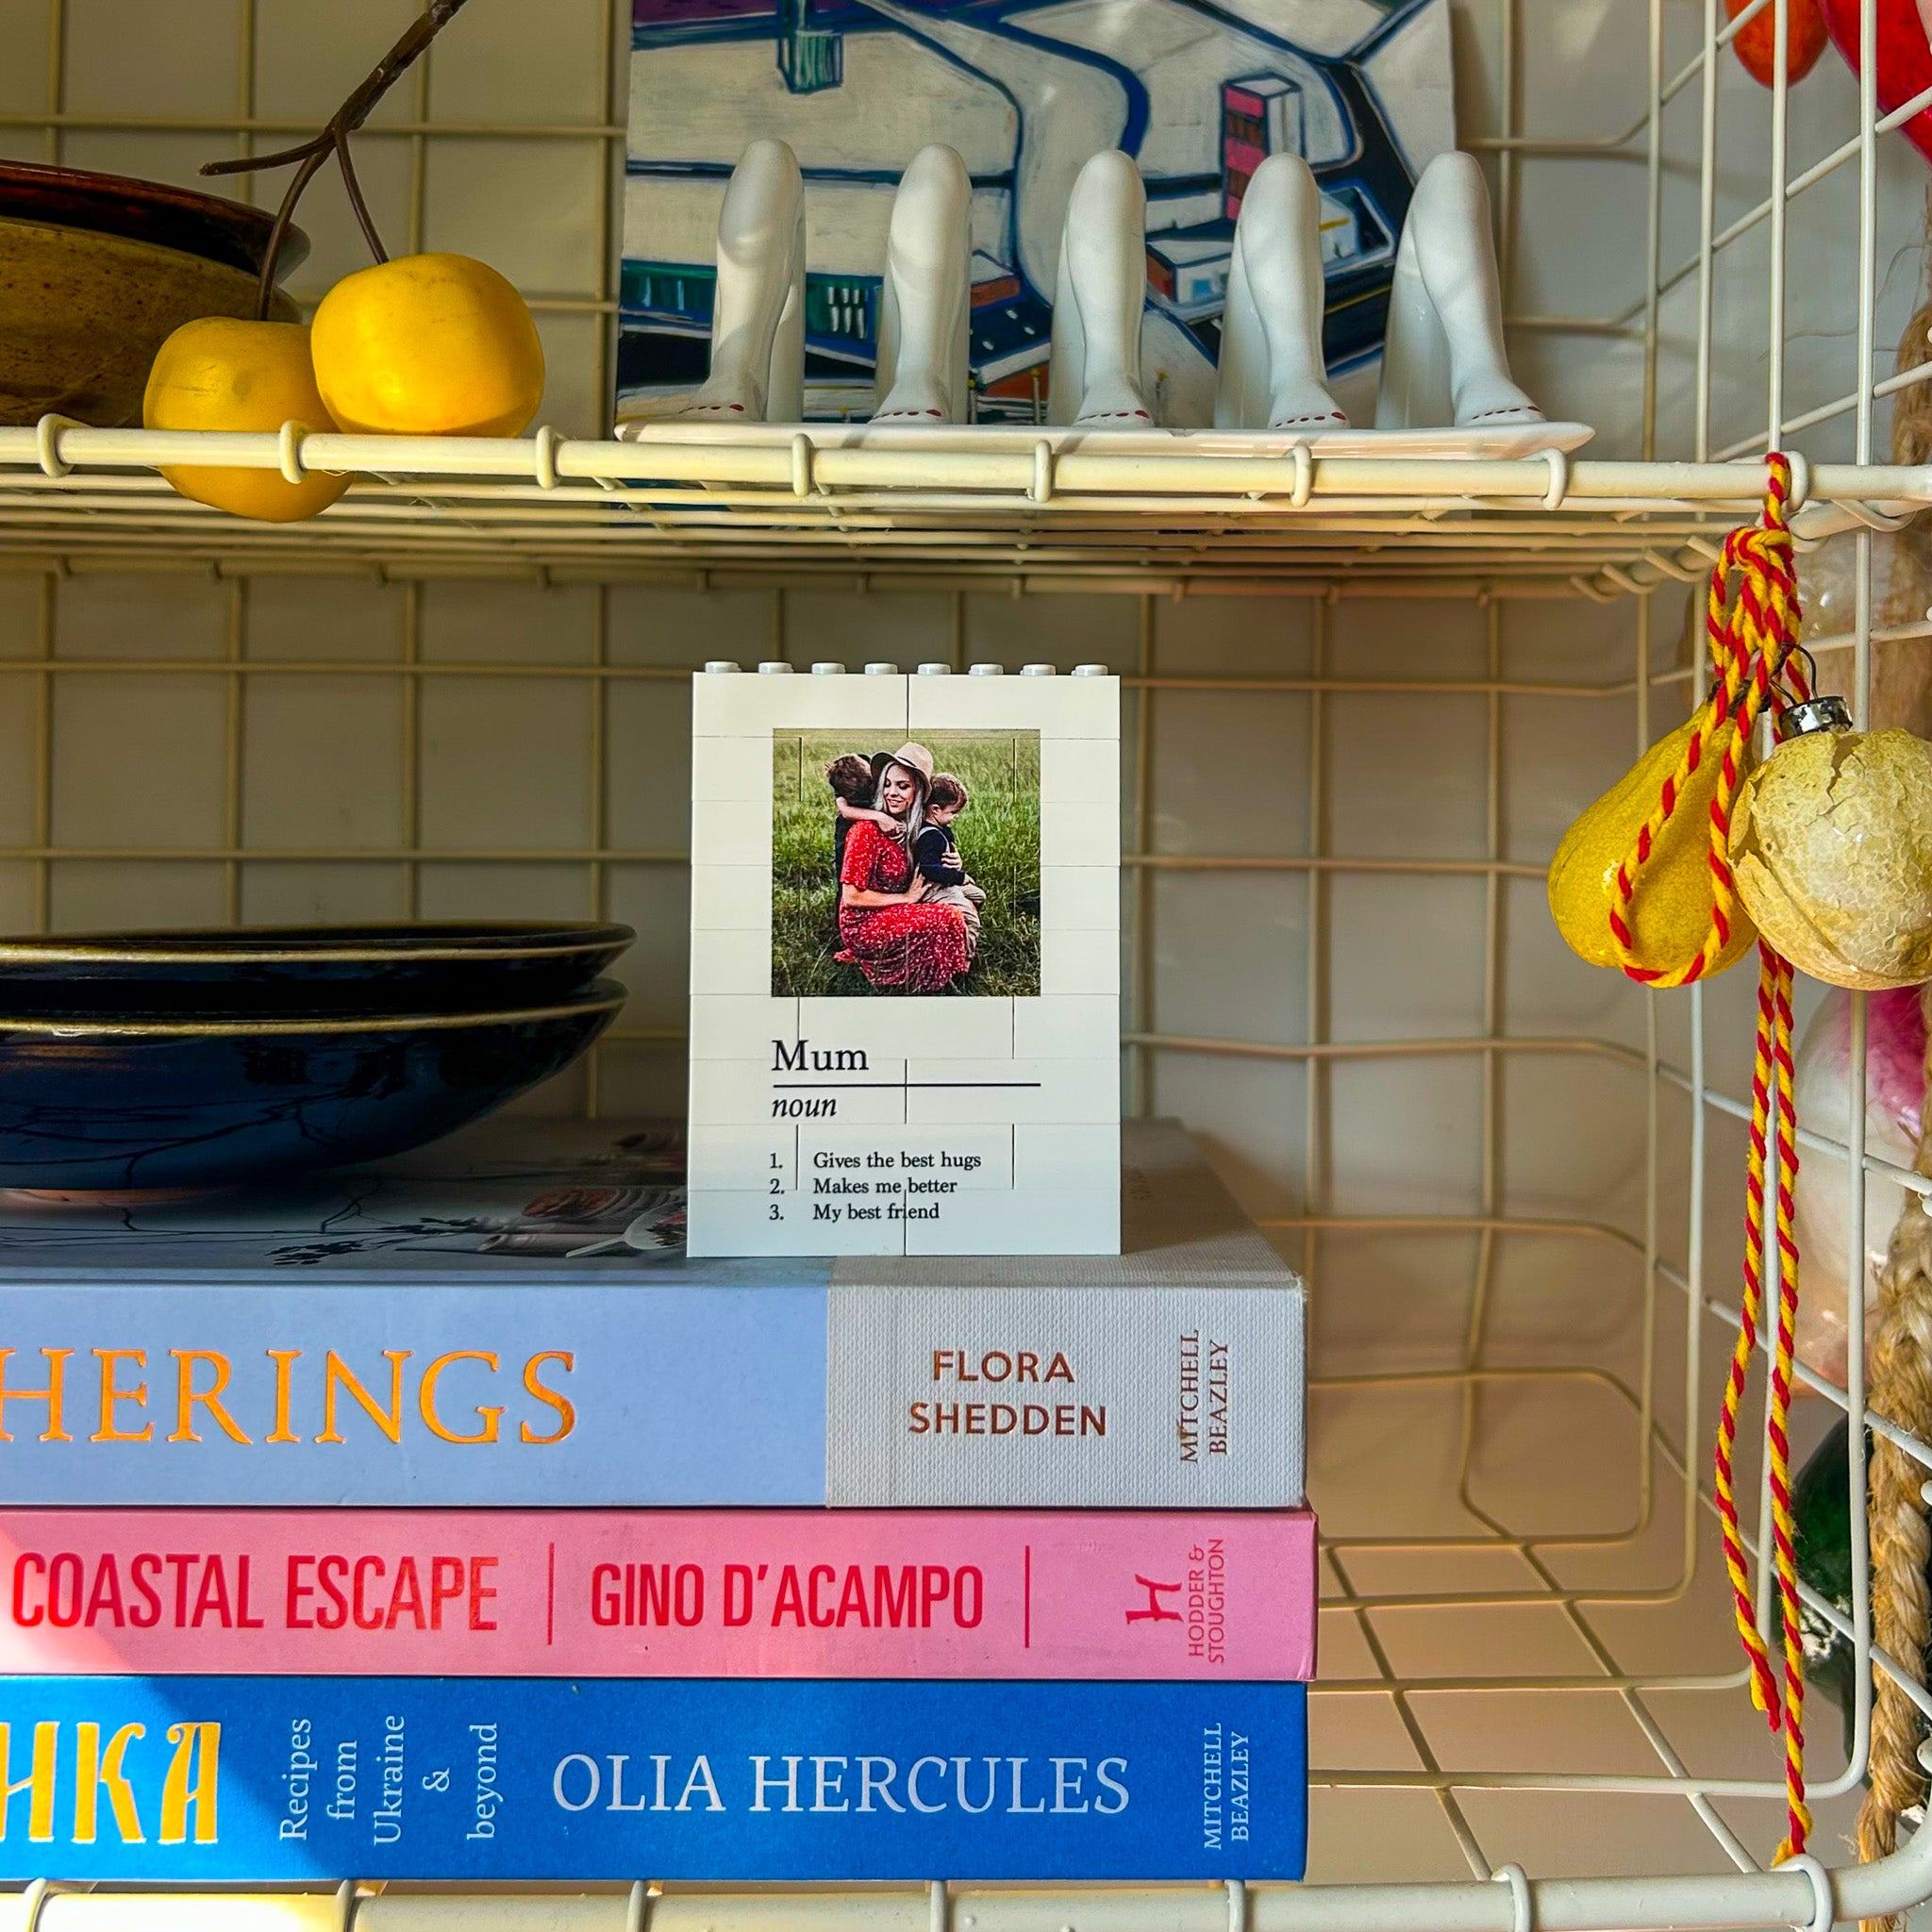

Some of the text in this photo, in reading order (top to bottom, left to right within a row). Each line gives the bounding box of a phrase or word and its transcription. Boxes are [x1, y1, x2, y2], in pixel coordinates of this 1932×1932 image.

[772, 1040, 869, 1071] Mum
[772, 1098, 837, 1117] noun
[770, 1177, 958, 1194] 2. Makes me better
[771, 1151, 981, 1171] 1. Gives the best hugs
[770, 1203, 940, 1223] 3. My best friend
[0, 1348, 575, 1444] HERINGS
[934, 1351, 1074, 1383] FLORA
[1180, 1329, 1198, 1463] MITCHELL
[1209, 1340, 1227, 1455] BEAZLEY
[908, 1403, 1106, 1436] SHEDDEN
[12, 1553, 498, 1630] COASTAL ESCAPE
[591, 1563, 703, 1626] GINO
[1189, 1544, 1205, 1657] HODDER &
[1208, 1540, 1224, 1663] STOUGHTON
[280, 1719, 317, 1840] Recipes
[326, 1741, 357, 1820] from
[374, 1716, 404, 1845] Ukraine
[423, 1768, 449, 1791] &
[467, 1724, 502, 1840] beyond
[553, 1754, 1128, 1813] OLIA HERCULES
[1204, 1724, 1221, 1850] MITCHELL
[1231, 1732, 1248, 1840] BEAZLEY
